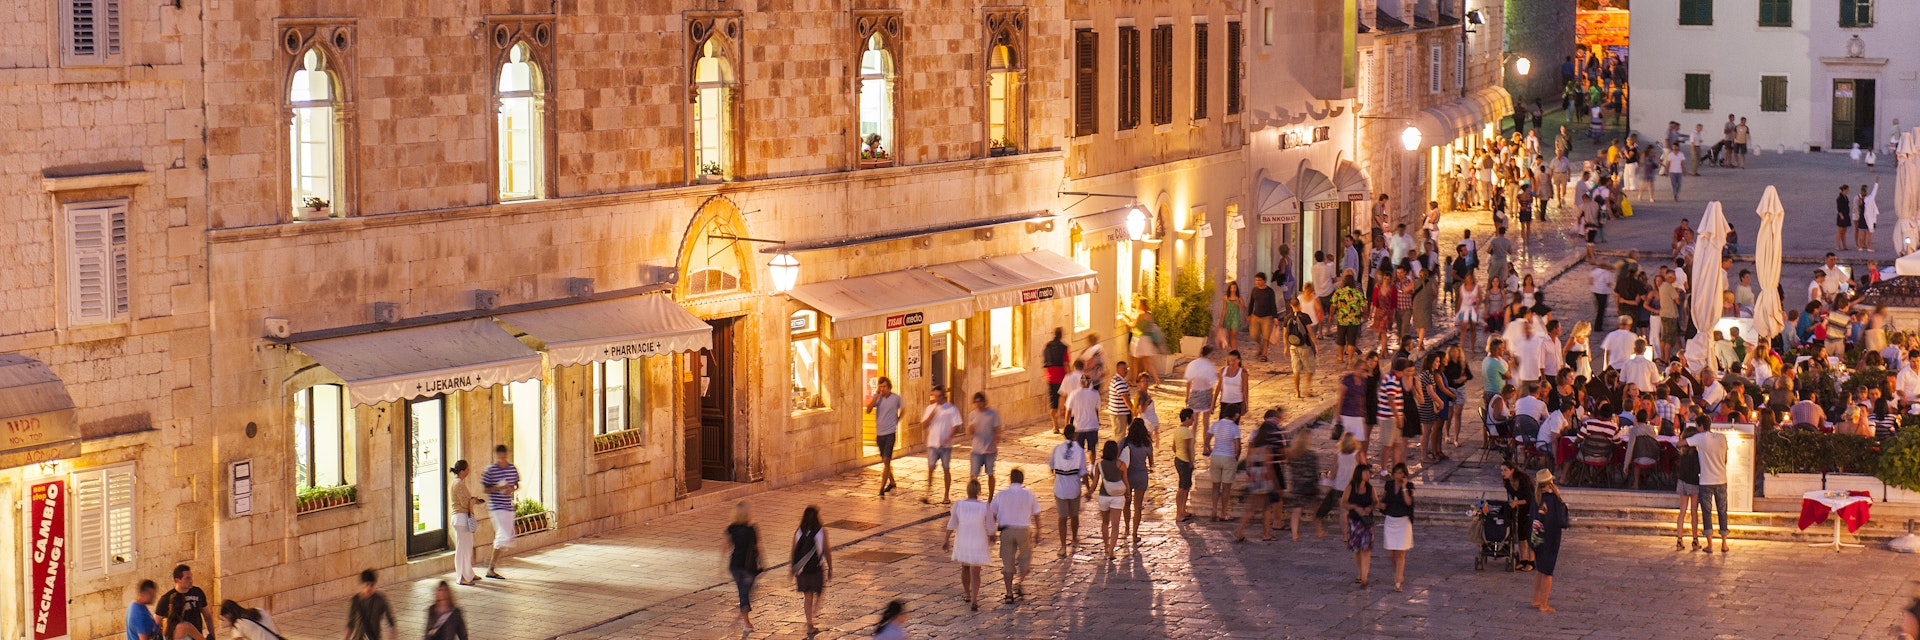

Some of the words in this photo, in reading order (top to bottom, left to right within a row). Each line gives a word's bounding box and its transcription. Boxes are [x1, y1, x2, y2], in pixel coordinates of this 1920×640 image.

[1314, 201, 1338, 210] SUPER
[1262, 215, 1296, 223] BANKOMAT
[887, 317, 903, 327] TISAK
[425, 376, 472, 392] LJEKARNA
[33, 493, 47, 501] stop
[34, 483, 59, 564] CAMBIO
[35, 536, 64, 634] EXCHANGE
